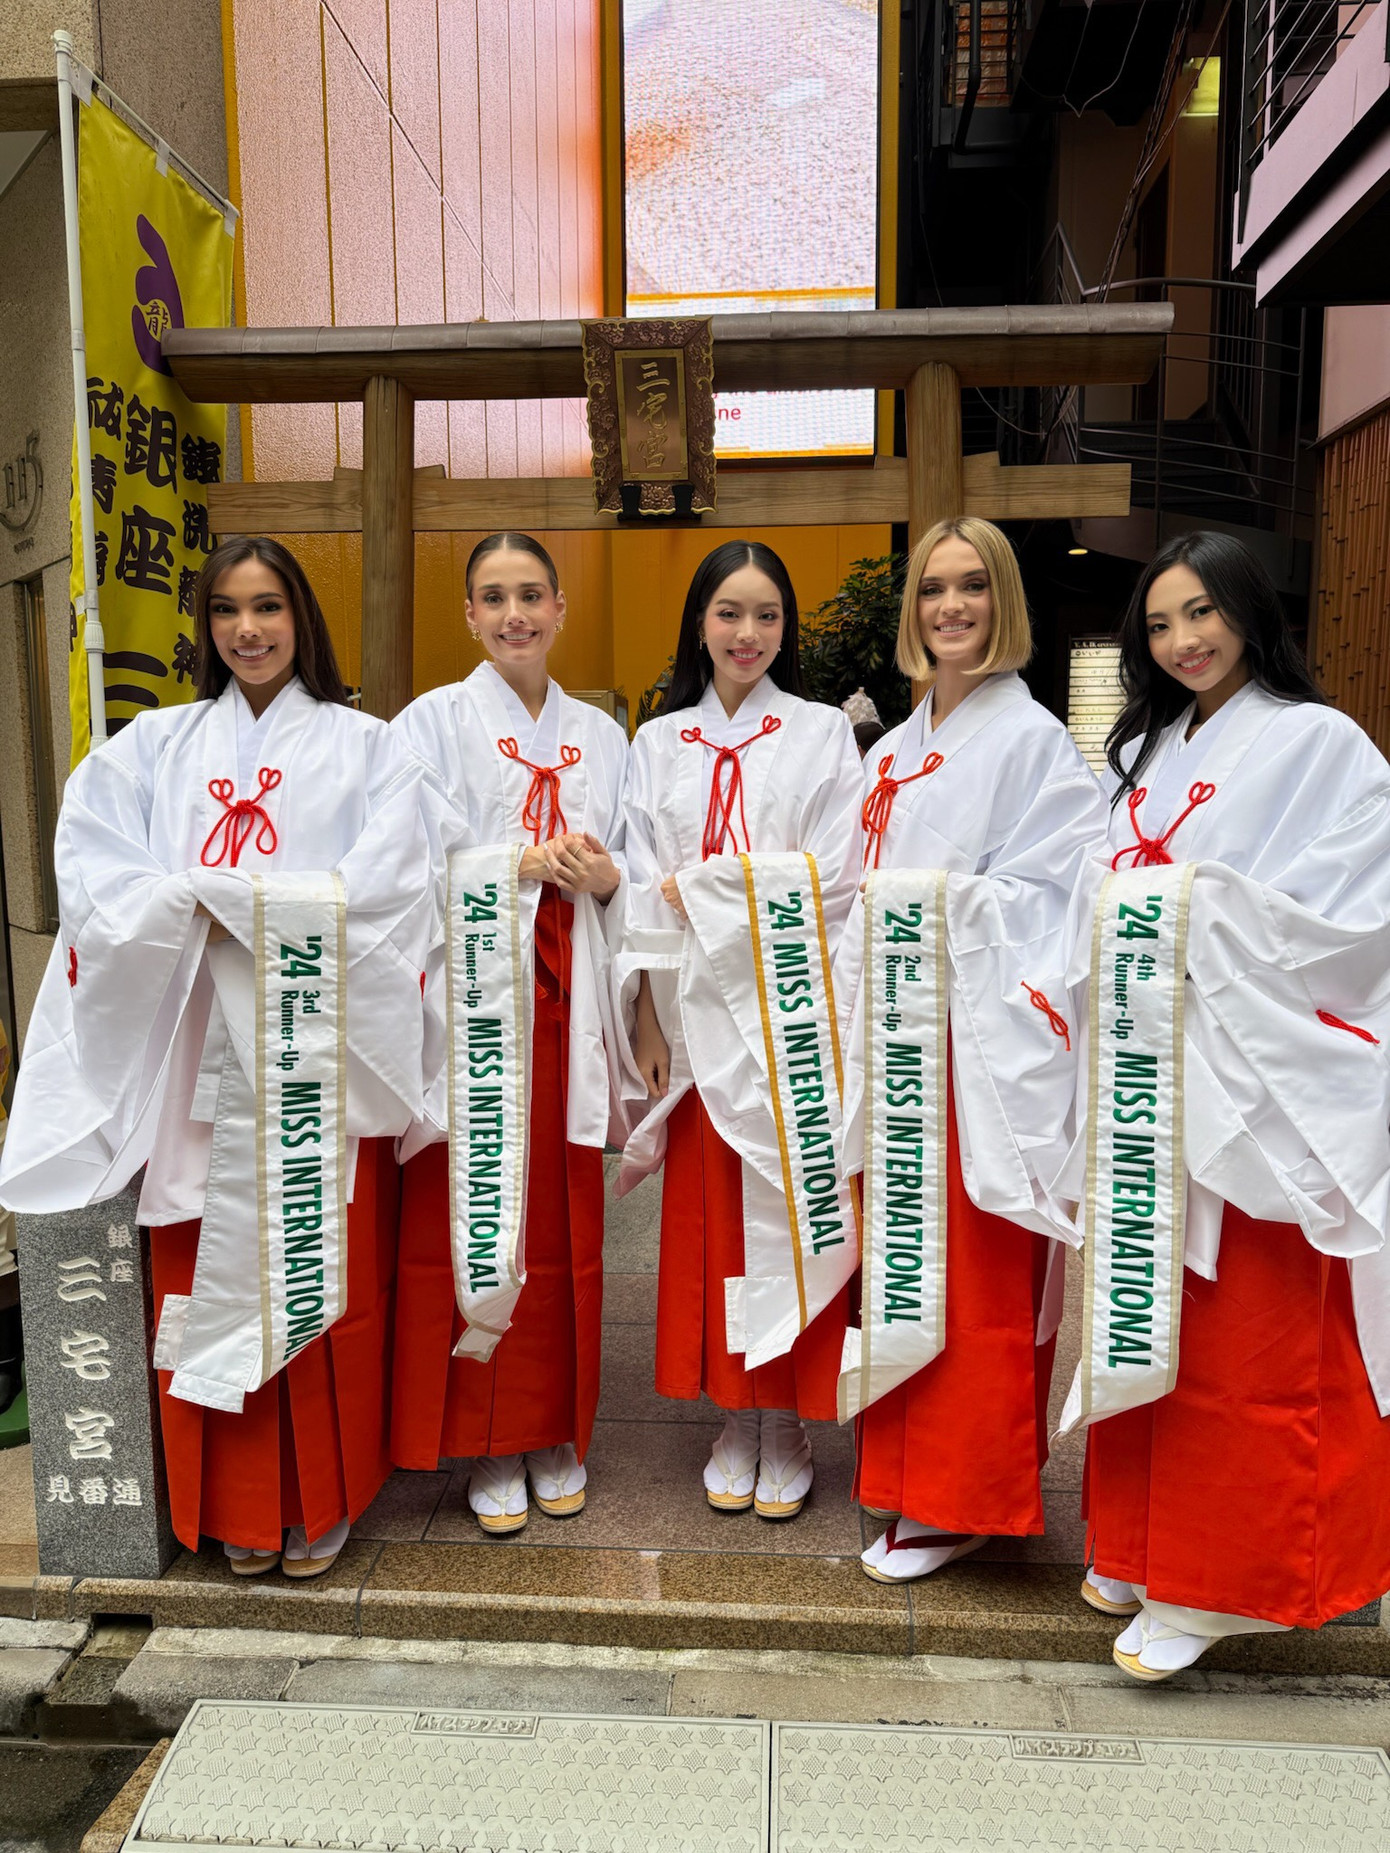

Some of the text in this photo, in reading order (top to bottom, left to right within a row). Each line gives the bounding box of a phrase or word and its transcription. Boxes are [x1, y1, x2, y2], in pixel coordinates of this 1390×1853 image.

[717, 408, 741, 420] ne
[280, 936, 323, 979] '24
[463, 933, 483, 1008] Runner-Up
[482, 932, 497, 952] 1st
[904, 954, 923, 982] 2nd
[1136, 953, 1157, 981] 4th
[302, 989, 321, 1014] 3rd
[881, 954, 901, 1032] Runner-Up
[1109, 953, 1134, 1040] Runner-Up
[276, 990, 299, 1071] Runner-Up
[463, 884, 504, 1293] '24 MISS INTERNATIONAL
[768, 891, 845, 1256] '24 MISS INTERNATIONAL
[281, 1082, 323, 1148] MISS
[884, 903, 924, 1325] '24 MISS INTERNATIONAL
[1108, 896, 1163, 1369] '24 MISS INTERNATIONAL
[107, 1224, 134, 1282] 銀座
[57, 1257, 115, 1460] 三宅宮
[48, 1474, 142, 1506] 見番通
